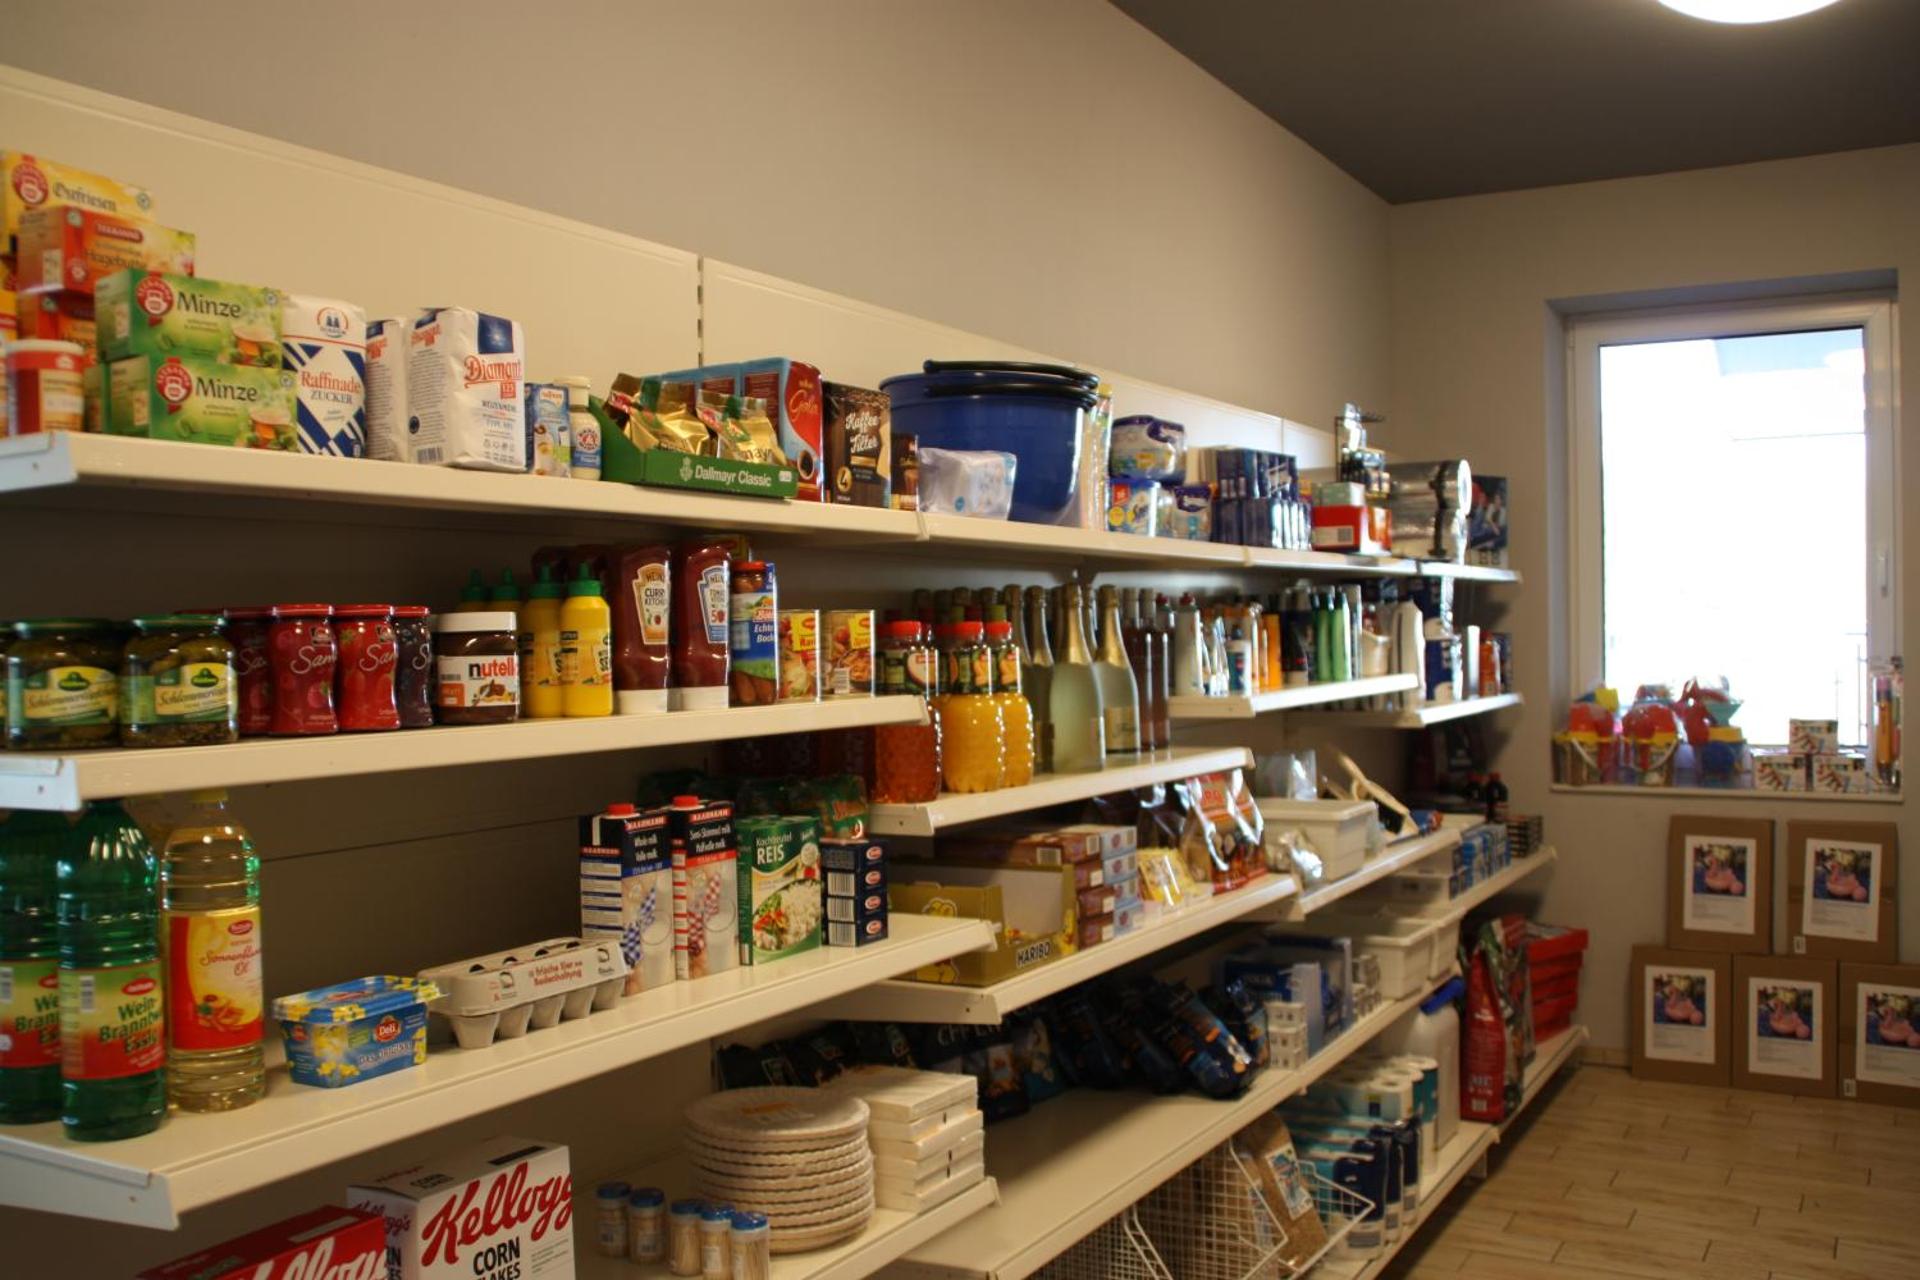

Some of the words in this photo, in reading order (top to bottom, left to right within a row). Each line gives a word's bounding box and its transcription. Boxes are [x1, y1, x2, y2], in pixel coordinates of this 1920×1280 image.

[177, 291, 241, 318] Minze
[196, 376, 258, 402] Minze
[301, 370, 361, 394] Raffinade
[311, 389, 353, 405] ZUCKER
[845, 411, 880, 435] Kaffee
[694, 464, 737, 486] Dallmayr
[737, 469, 773, 488] Classic
[469, 656, 516, 678] nutell
[757, 844, 785, 865] REIS
[1016, 940, 1052, 968] HARIBO
[473, 1237, 521, 1276] CORN
